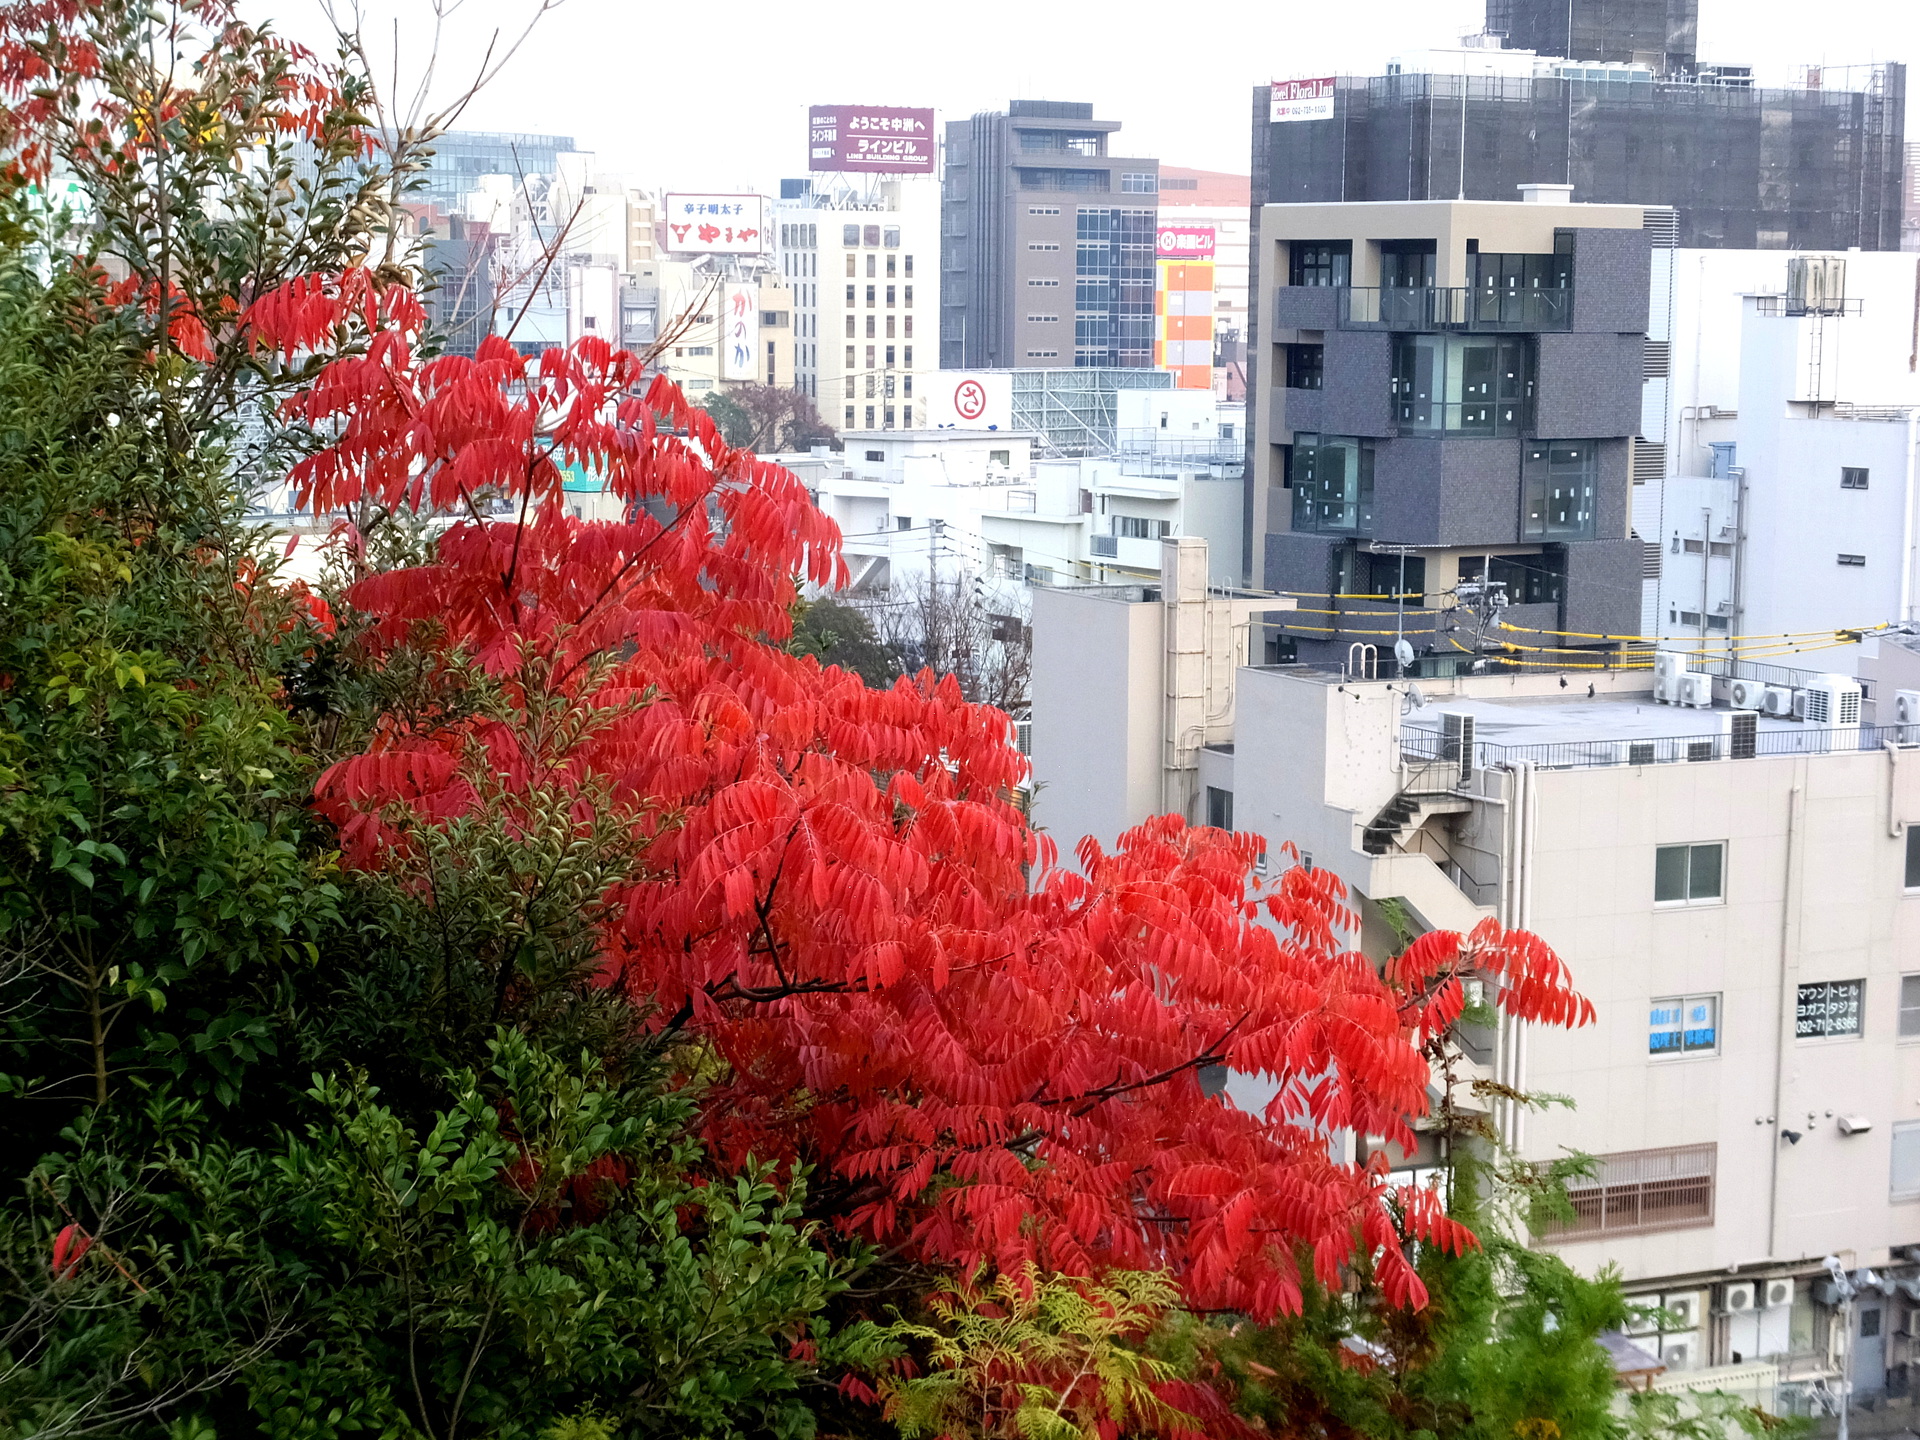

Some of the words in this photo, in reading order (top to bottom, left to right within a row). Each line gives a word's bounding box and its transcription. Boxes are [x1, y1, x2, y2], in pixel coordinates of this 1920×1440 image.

[1271, 85, 1289, 101] Hotel
[1290, 81, 1316, 100] Floral
[1318, 80, 1334, 98] Inn
[849, 116, 926, 132] ようこそ中洲へ
[857, 139, 917, 155] ラインビル
[846, 153, 864, 161] LINE
[866, 154, 901, 162] BUILDING
[684, 203, 743, 215] 辛子明太子
[697, 223, 758, 244] やまや
[731, 287, 753, 369] かのか
[1797, 984, 1859, 1001] マウントヒル
[1797, 1000, 1859, 1017] ヨガスタジオ
